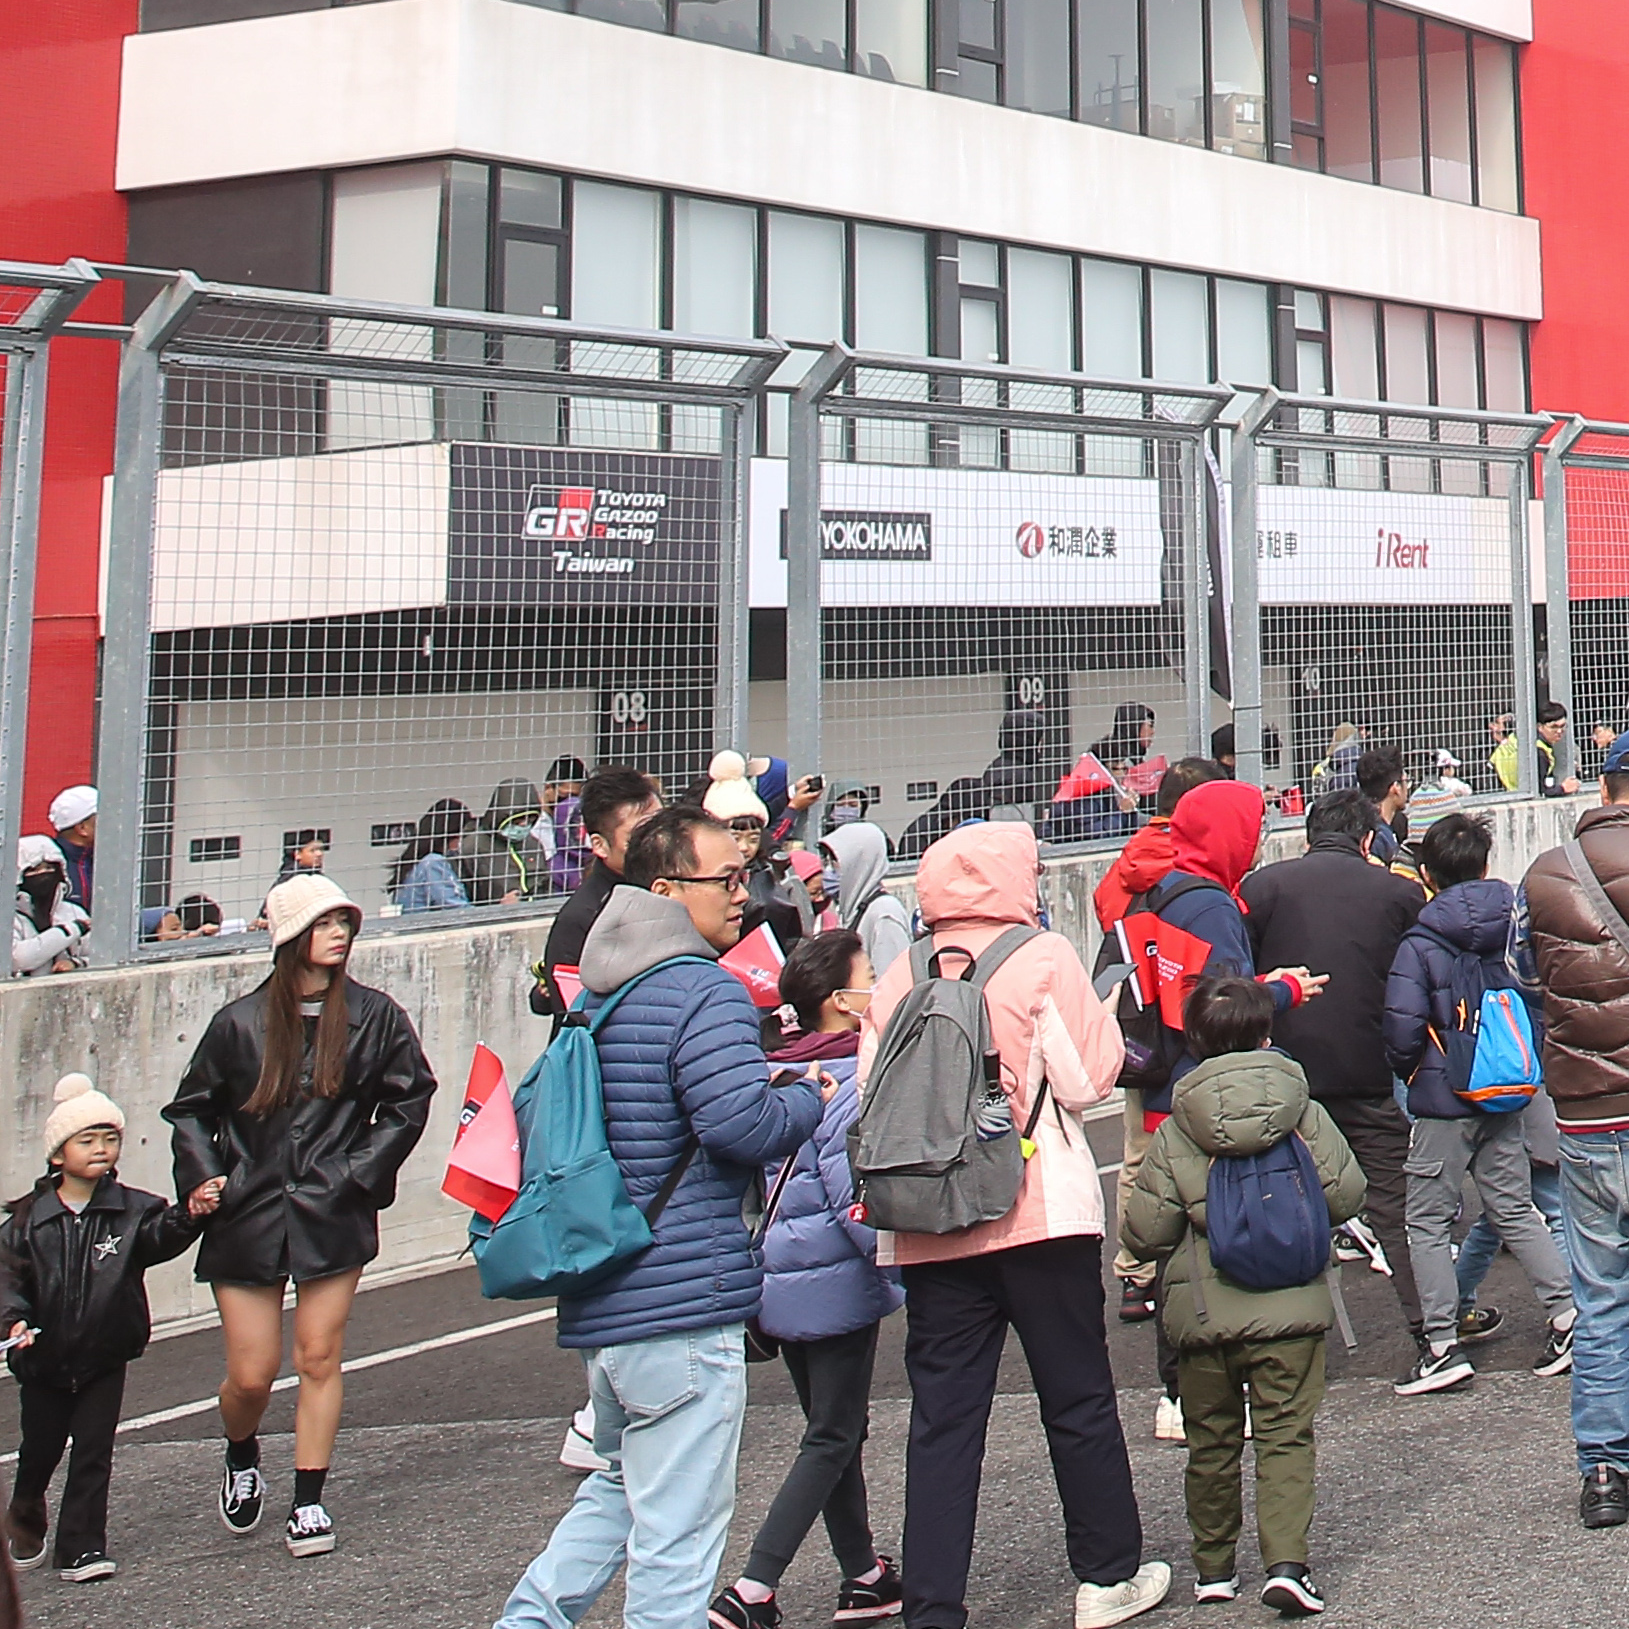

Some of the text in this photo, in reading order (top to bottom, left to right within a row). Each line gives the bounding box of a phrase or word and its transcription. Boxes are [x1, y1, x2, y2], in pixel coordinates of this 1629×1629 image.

[597, 489, 666, 508] TOYOTA
[525, 507, 588, 537] GR
[594, 507, 659, 524] GAZOO
[593, 524, 655, 544] Racing
[820, 520, 927, 551] YOKOHAMA
[1048, 524, 1118, 559] 和潤企業
[553, 550, 635, 573] Taiwan
[1019, 677, 1044, 704] 09
[613, 692, 646, 723] 08
